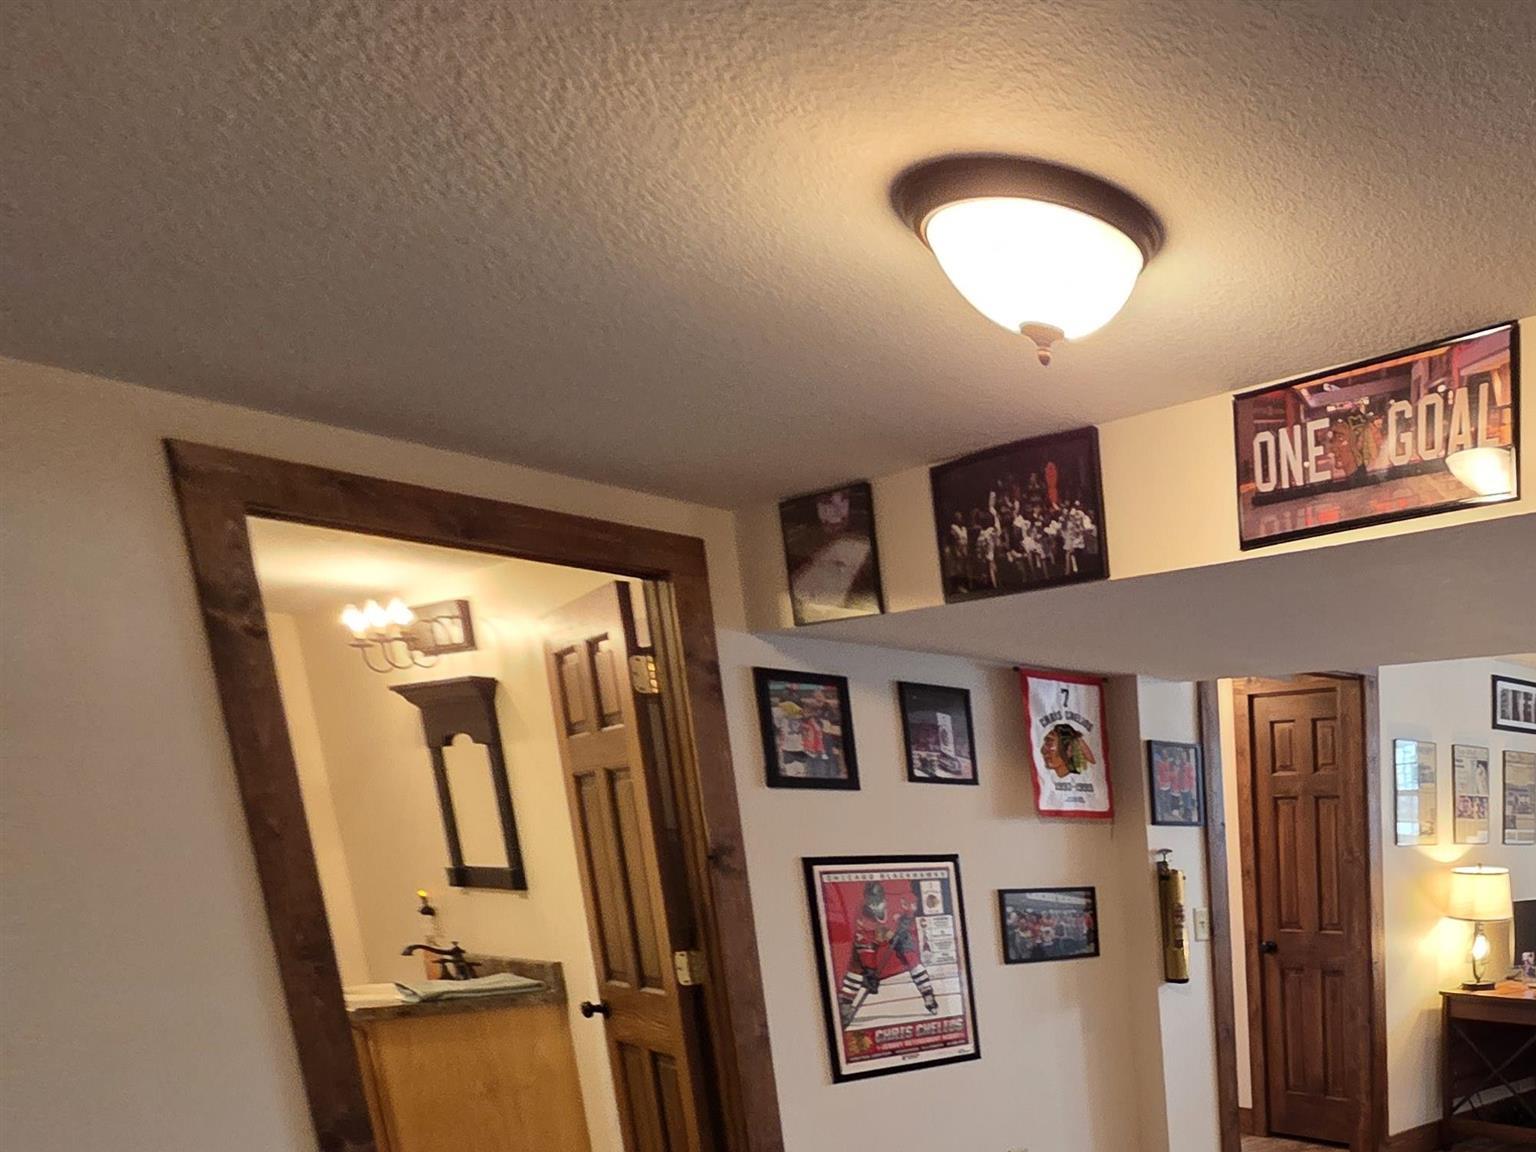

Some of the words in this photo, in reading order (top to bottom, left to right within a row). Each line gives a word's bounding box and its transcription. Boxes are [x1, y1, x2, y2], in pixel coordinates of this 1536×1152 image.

[1252, 417, 1332, 493] ONE
[1388, 382, 1499, 466] GOAL
[1060, 688, 1070, 708] 7
